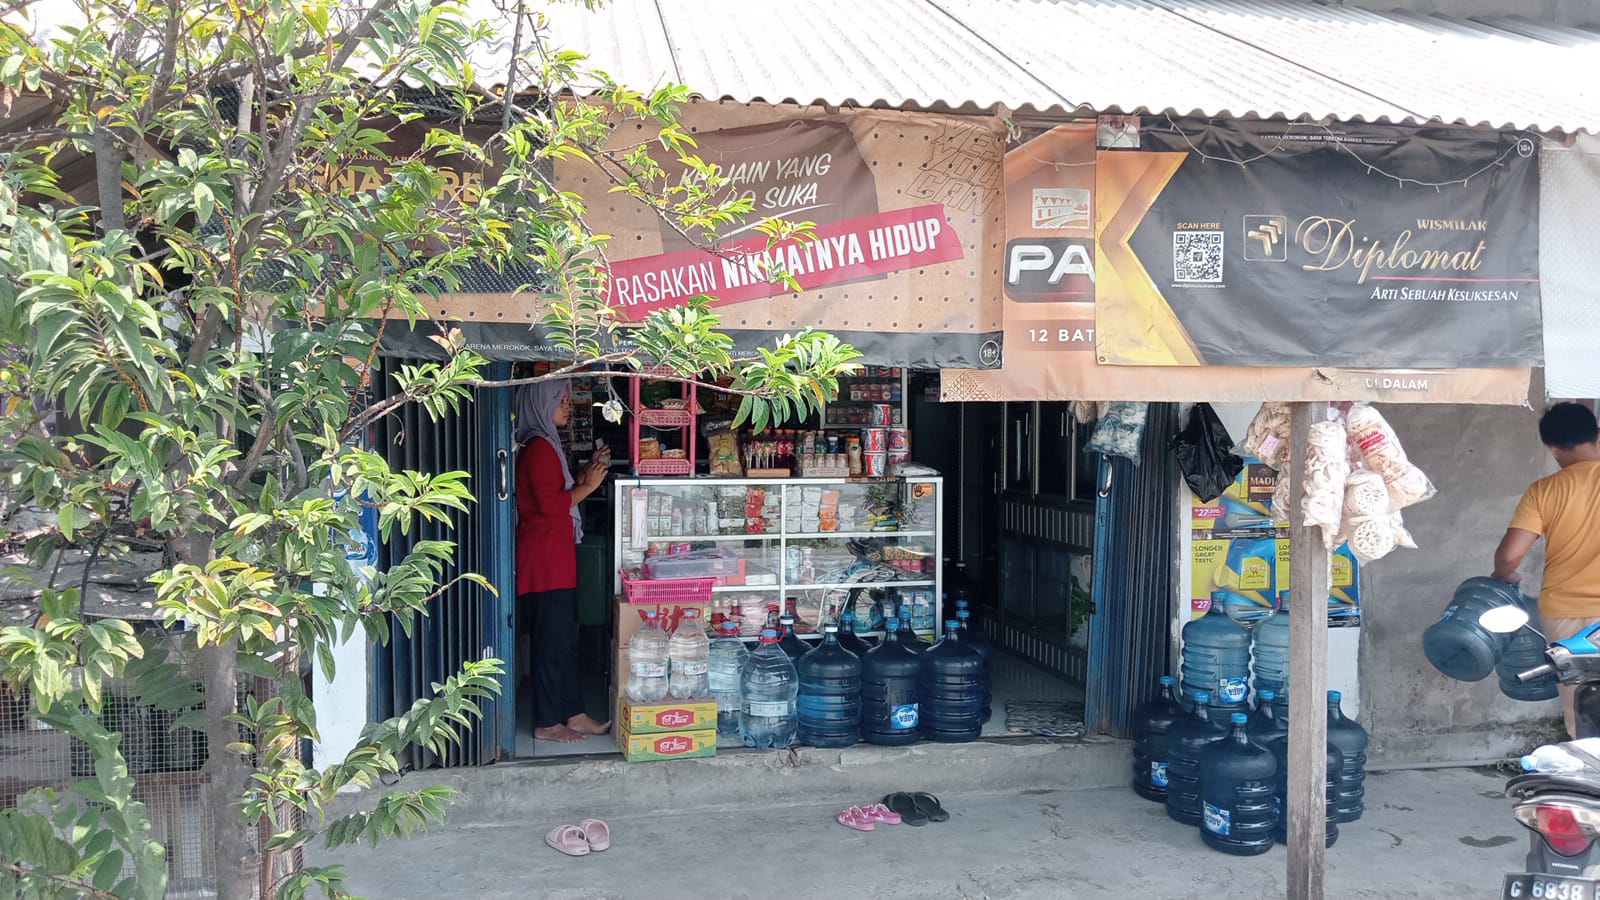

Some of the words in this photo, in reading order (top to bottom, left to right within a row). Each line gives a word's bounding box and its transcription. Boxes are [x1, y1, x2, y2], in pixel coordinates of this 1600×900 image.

[776, 153, 832, 181] YANG
[762, 182, 818, 209] SUKA
[1177, 222, 1199, 230] SCAN
[1200, 222, 1221, 230] HERE
[1417, 219, 1487, 232] WISMILAK
[1295, 215, 1487, 285] Diplomat
[616, 261, 717, 306] RASAKAN
[721, 233, 865, 289] NIKMATNYA
[869, 218, 940, 261] HIDUP
[1030, 329, 1048, 342] 12
[1383, 378, 1428, 390] DALAM
[1551, 862, 1580, 870] HONDA
[1532, 881, 1583, 900] 6838
